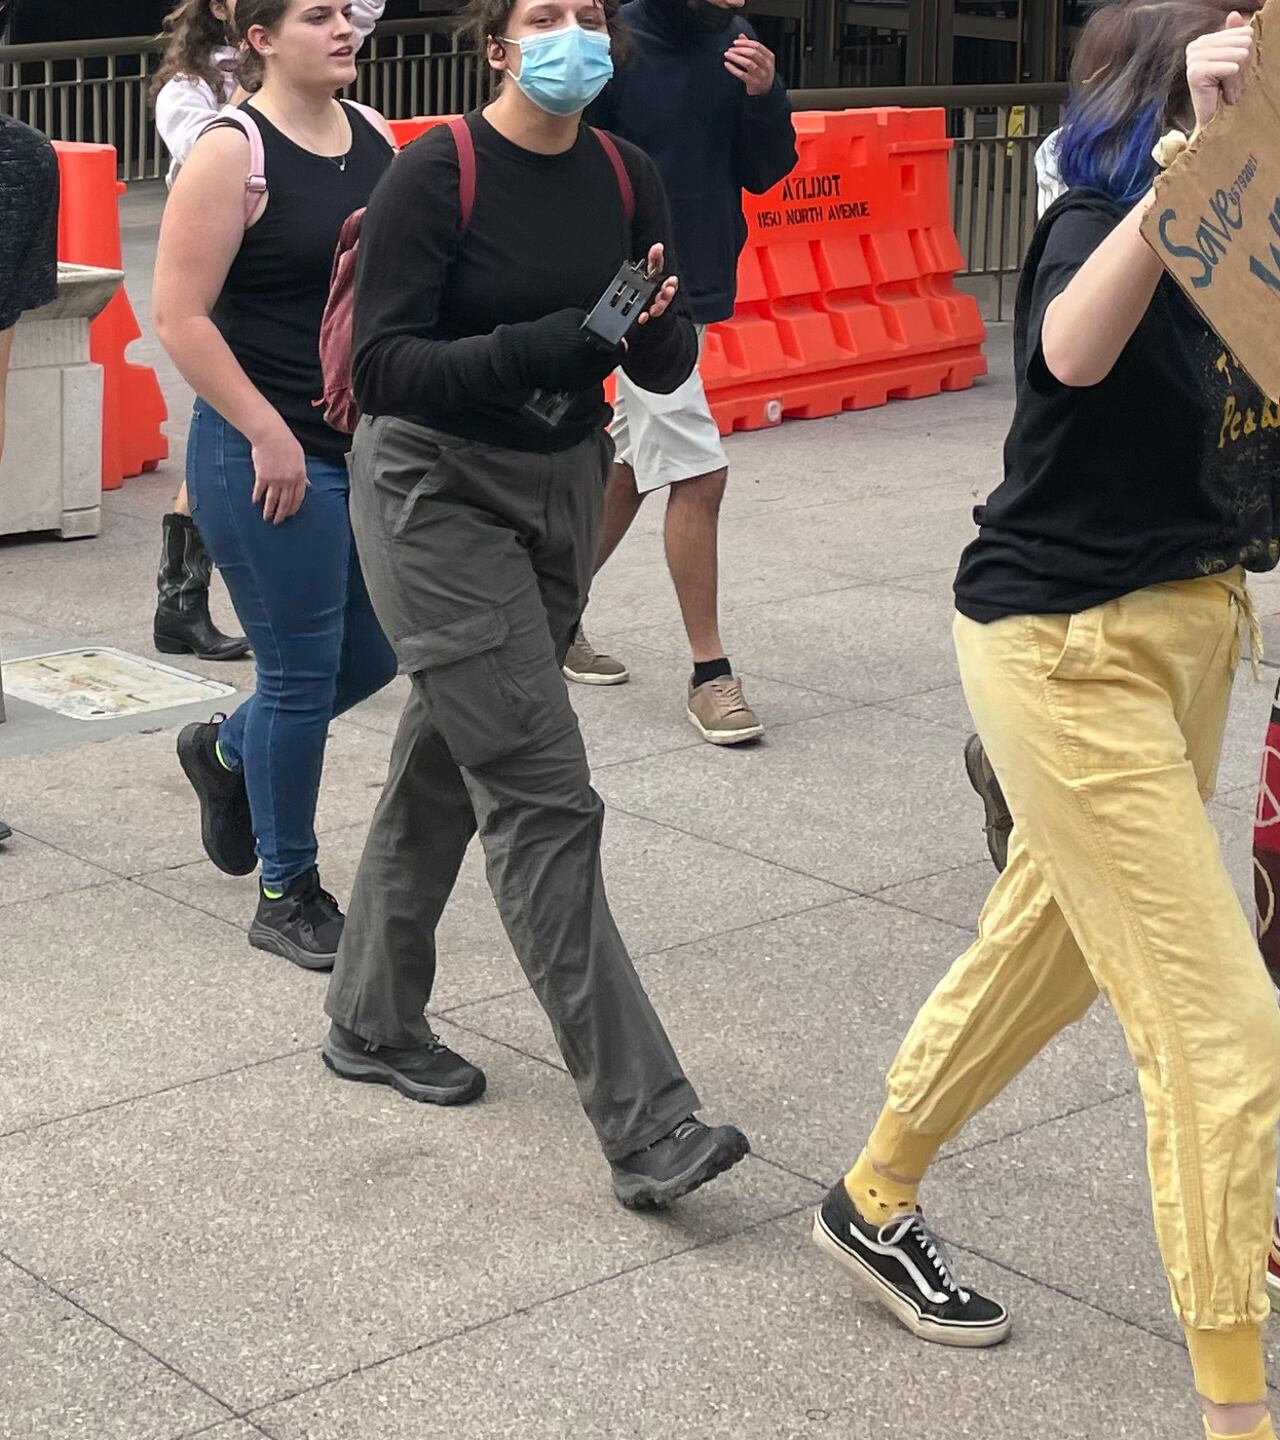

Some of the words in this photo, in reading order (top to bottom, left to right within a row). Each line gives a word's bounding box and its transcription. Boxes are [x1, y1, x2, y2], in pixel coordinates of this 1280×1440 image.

[782, 174, 841, 201] ATLDOT
[757, 211, 782, 228] 1150
[785, 206, 823, 225] NORTH
[828, 201, 871, 220] AVENUE
[1158, 188, 1243, 289] Save
